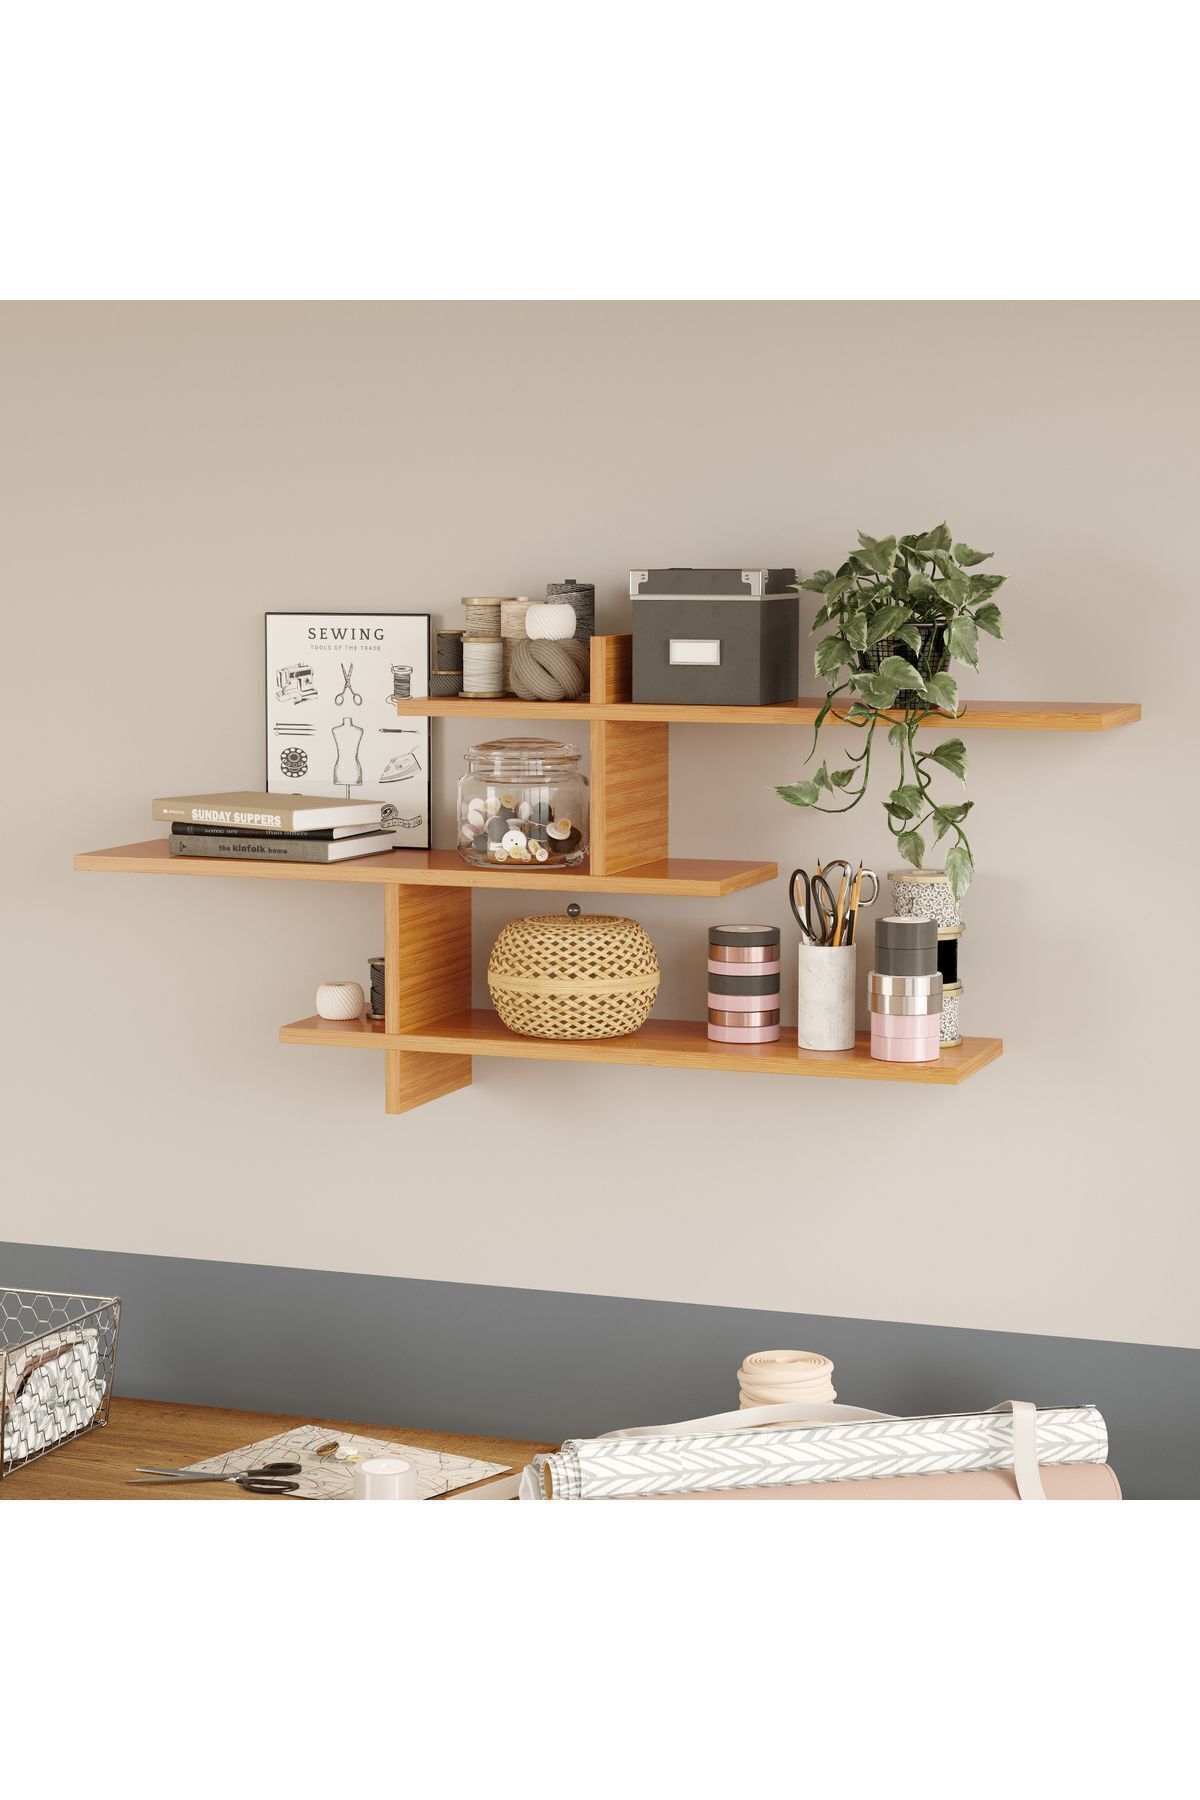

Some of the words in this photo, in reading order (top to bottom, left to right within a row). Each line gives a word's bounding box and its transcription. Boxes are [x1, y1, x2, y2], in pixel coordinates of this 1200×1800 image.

[308, 627, 385, 640] SEWING
[191, 808, 231, 821] SUNDAY
[234, 812, 282, 826] SUPPERS
[219, 844, 231, 852] the
[232, 844, 266, 854] kinfolk
[268, 847, 288, 855] home
